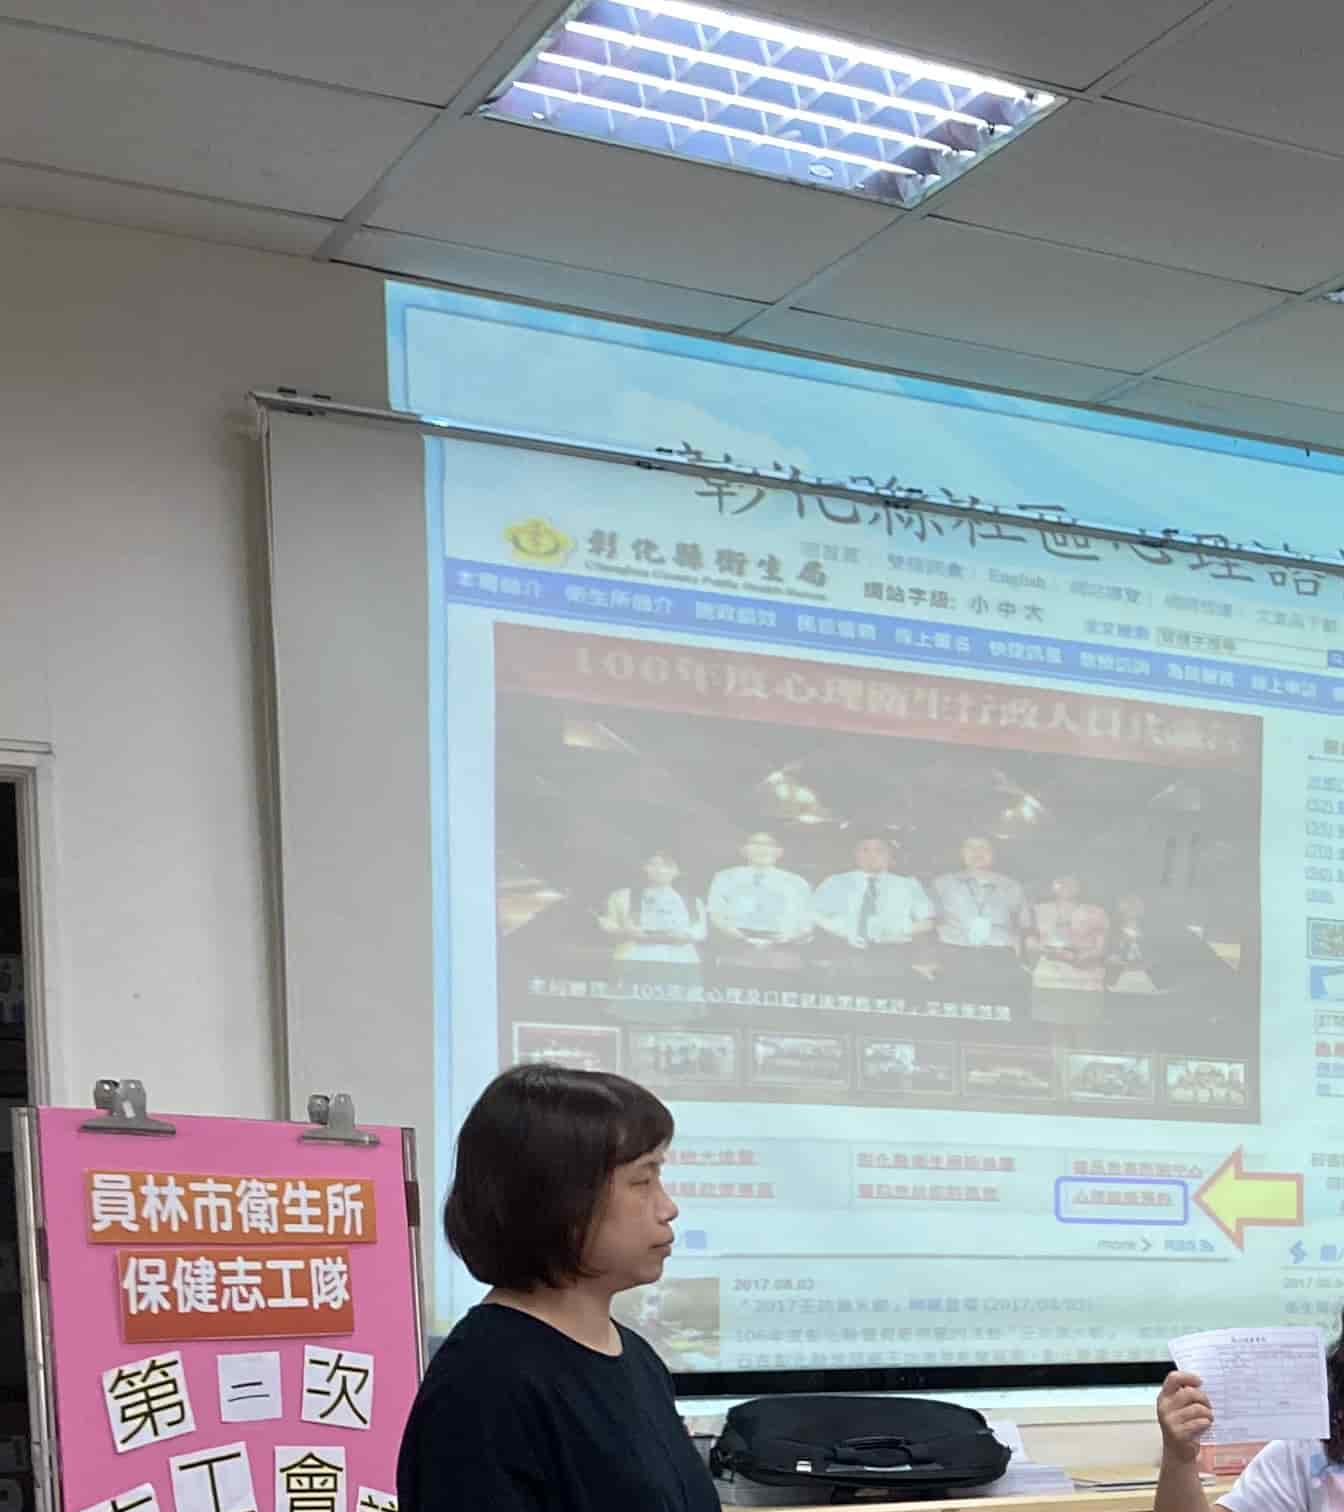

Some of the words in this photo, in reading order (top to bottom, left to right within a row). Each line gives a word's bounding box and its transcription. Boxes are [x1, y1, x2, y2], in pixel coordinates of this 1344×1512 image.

[91, 1173, 365, 1236] 員林市衛生所
[122, 1256, 351, 1315] 保健志工隊
[108, 1353, 370, 1444] 第二次
